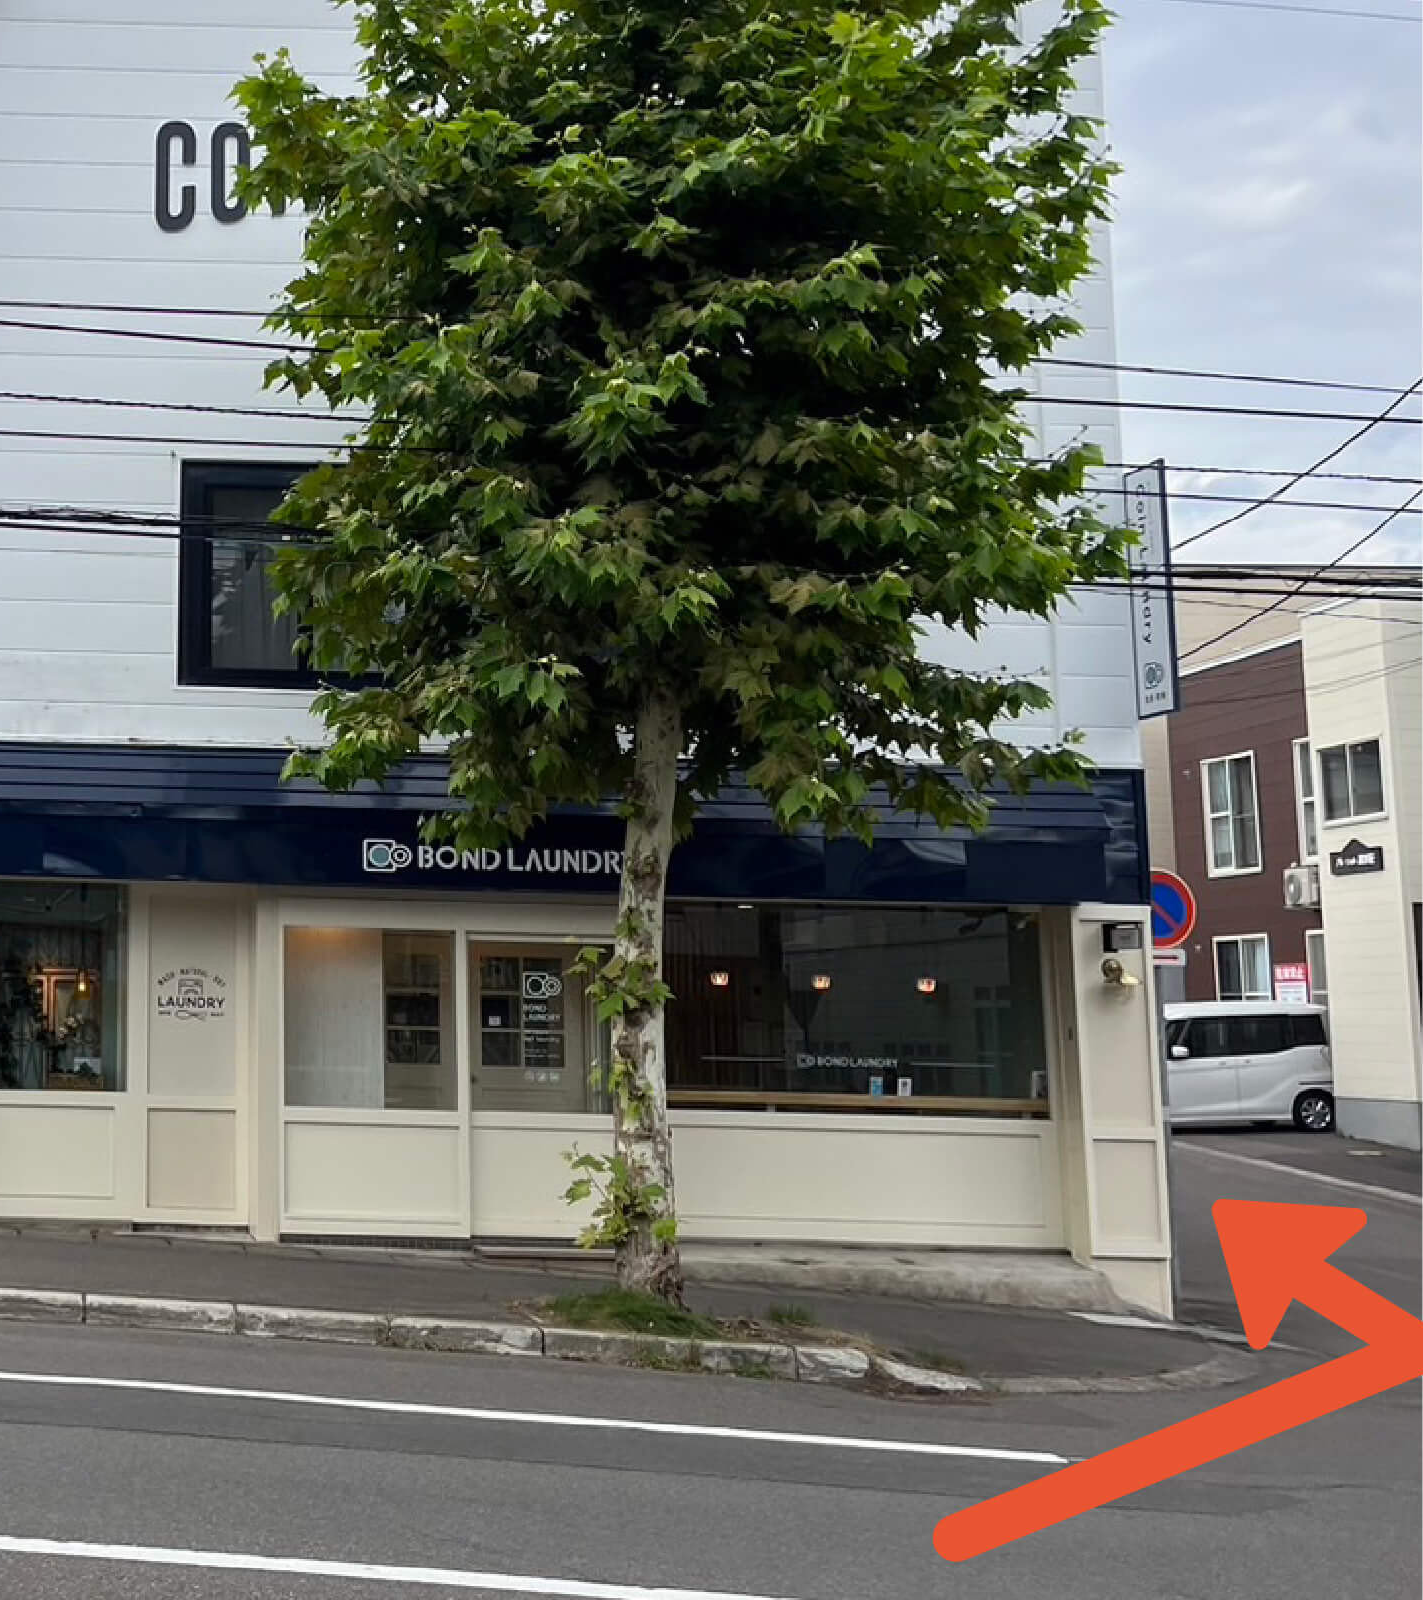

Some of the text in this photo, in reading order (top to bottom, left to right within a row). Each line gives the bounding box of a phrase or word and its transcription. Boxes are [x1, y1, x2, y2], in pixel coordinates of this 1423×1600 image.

[418, 846, 626, 874] BOND LAUNDR
[157, 995, 226, 1009] LAUNDRY
[817, 1056, 849, 1067] BOND
